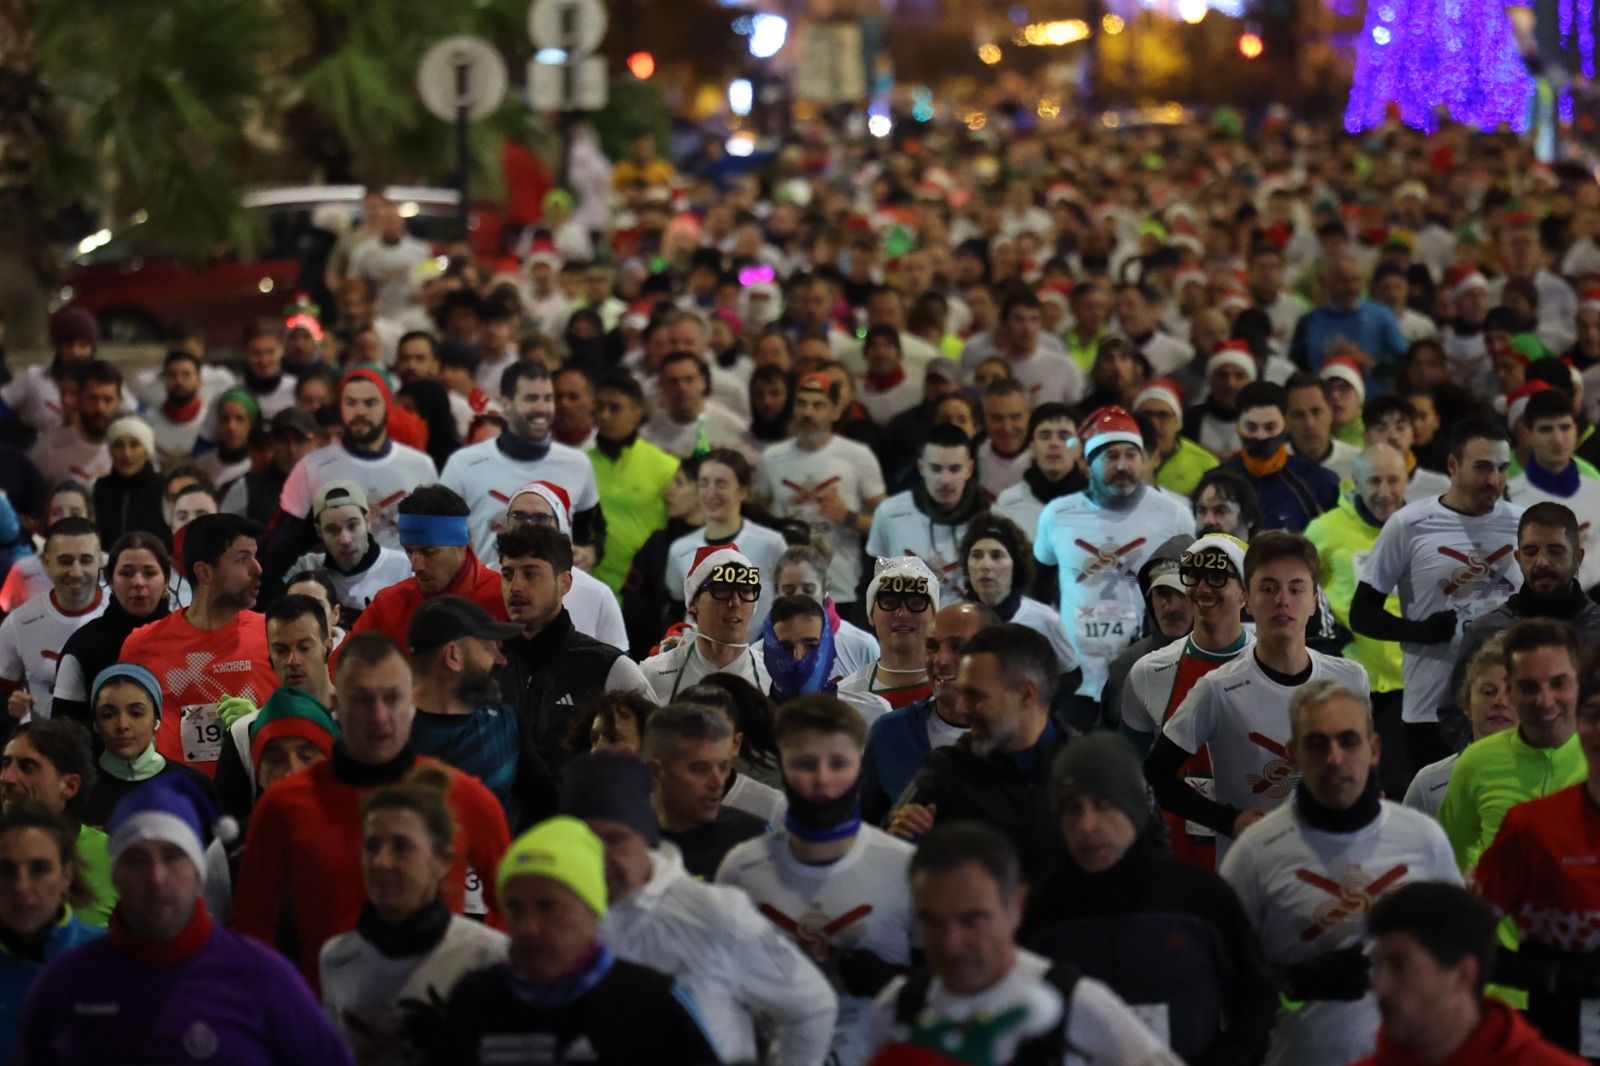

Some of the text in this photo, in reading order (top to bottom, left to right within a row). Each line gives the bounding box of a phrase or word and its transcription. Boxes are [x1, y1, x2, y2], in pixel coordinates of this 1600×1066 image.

[1182, 552, 1228, 569] 2025
[712, 565, 759, 585] 2025
[880, 576, 928, 594] 2025
[1085, 621, 1124, 638] 1174
[213, 665, 252, 673] ARMOUR
